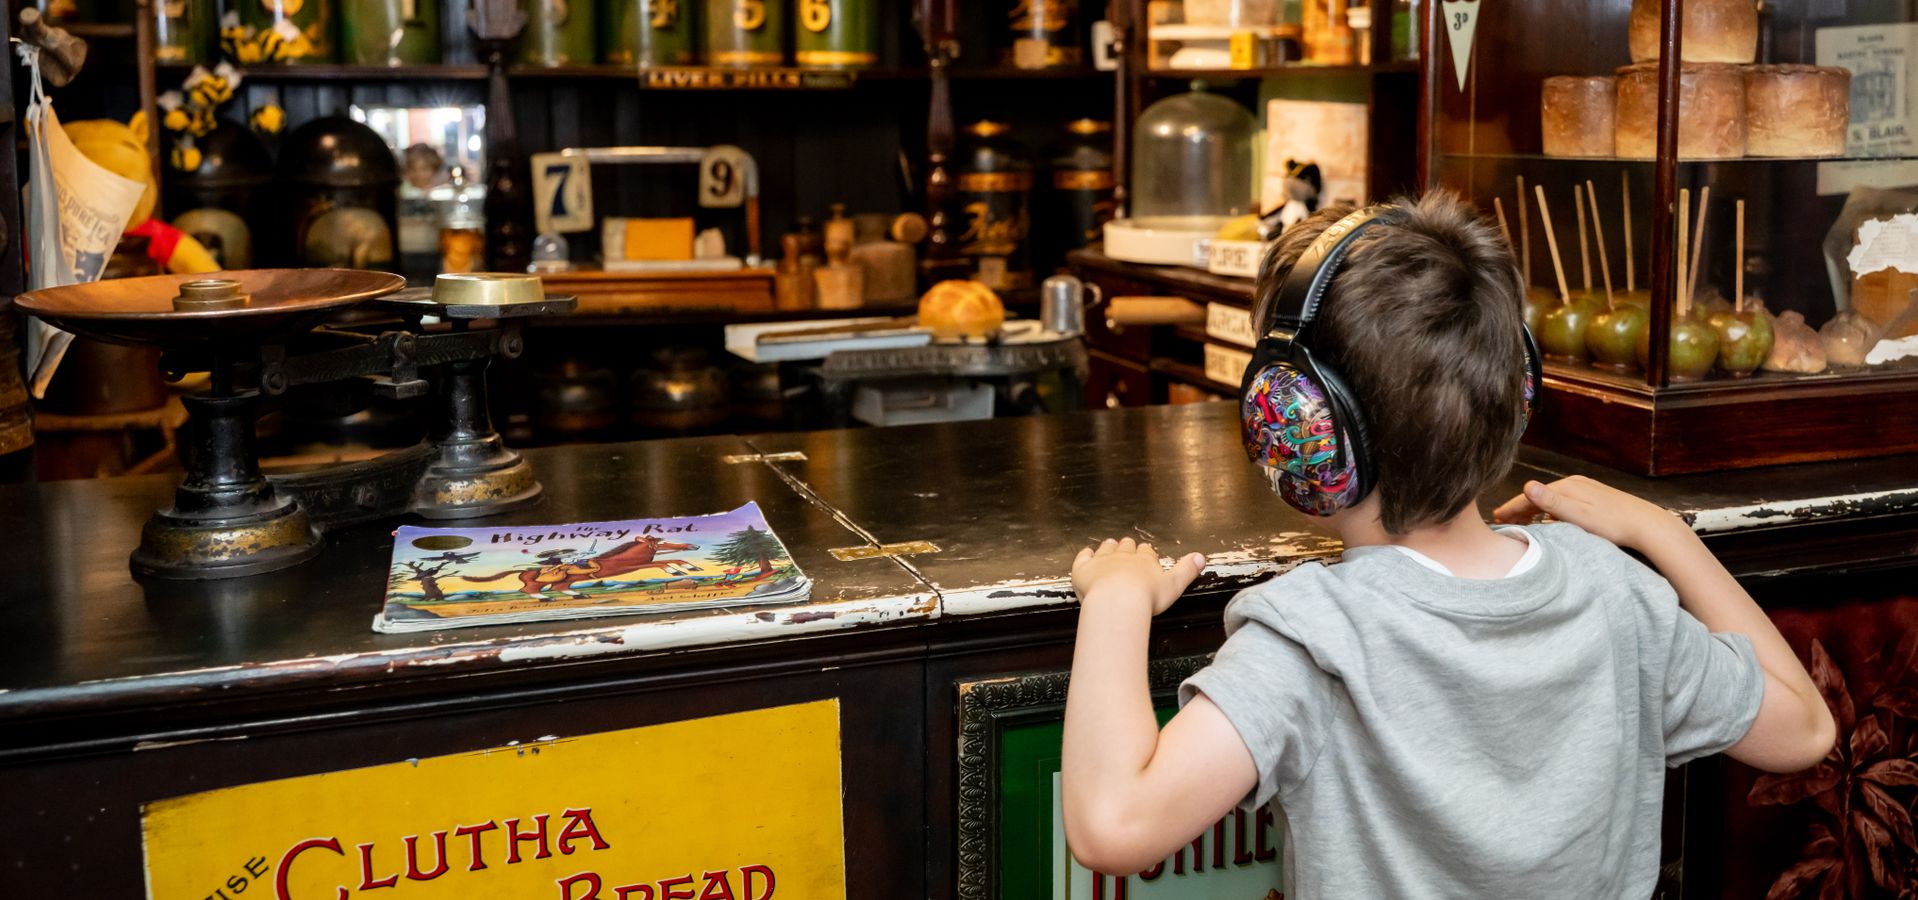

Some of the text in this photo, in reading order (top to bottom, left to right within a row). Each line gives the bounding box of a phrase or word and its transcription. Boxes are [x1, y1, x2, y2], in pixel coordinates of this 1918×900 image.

[733, 0, 766, 31] 5
[800, 0, 831, 32] 6
[545, 164, 571, 216] 7
[709, 160, 733, 198] 9
[491, 523, 699, 546] Highway Rat
[274, 807, 610, 900] CLUTHA
[204, 856, 269, 900] ISE
